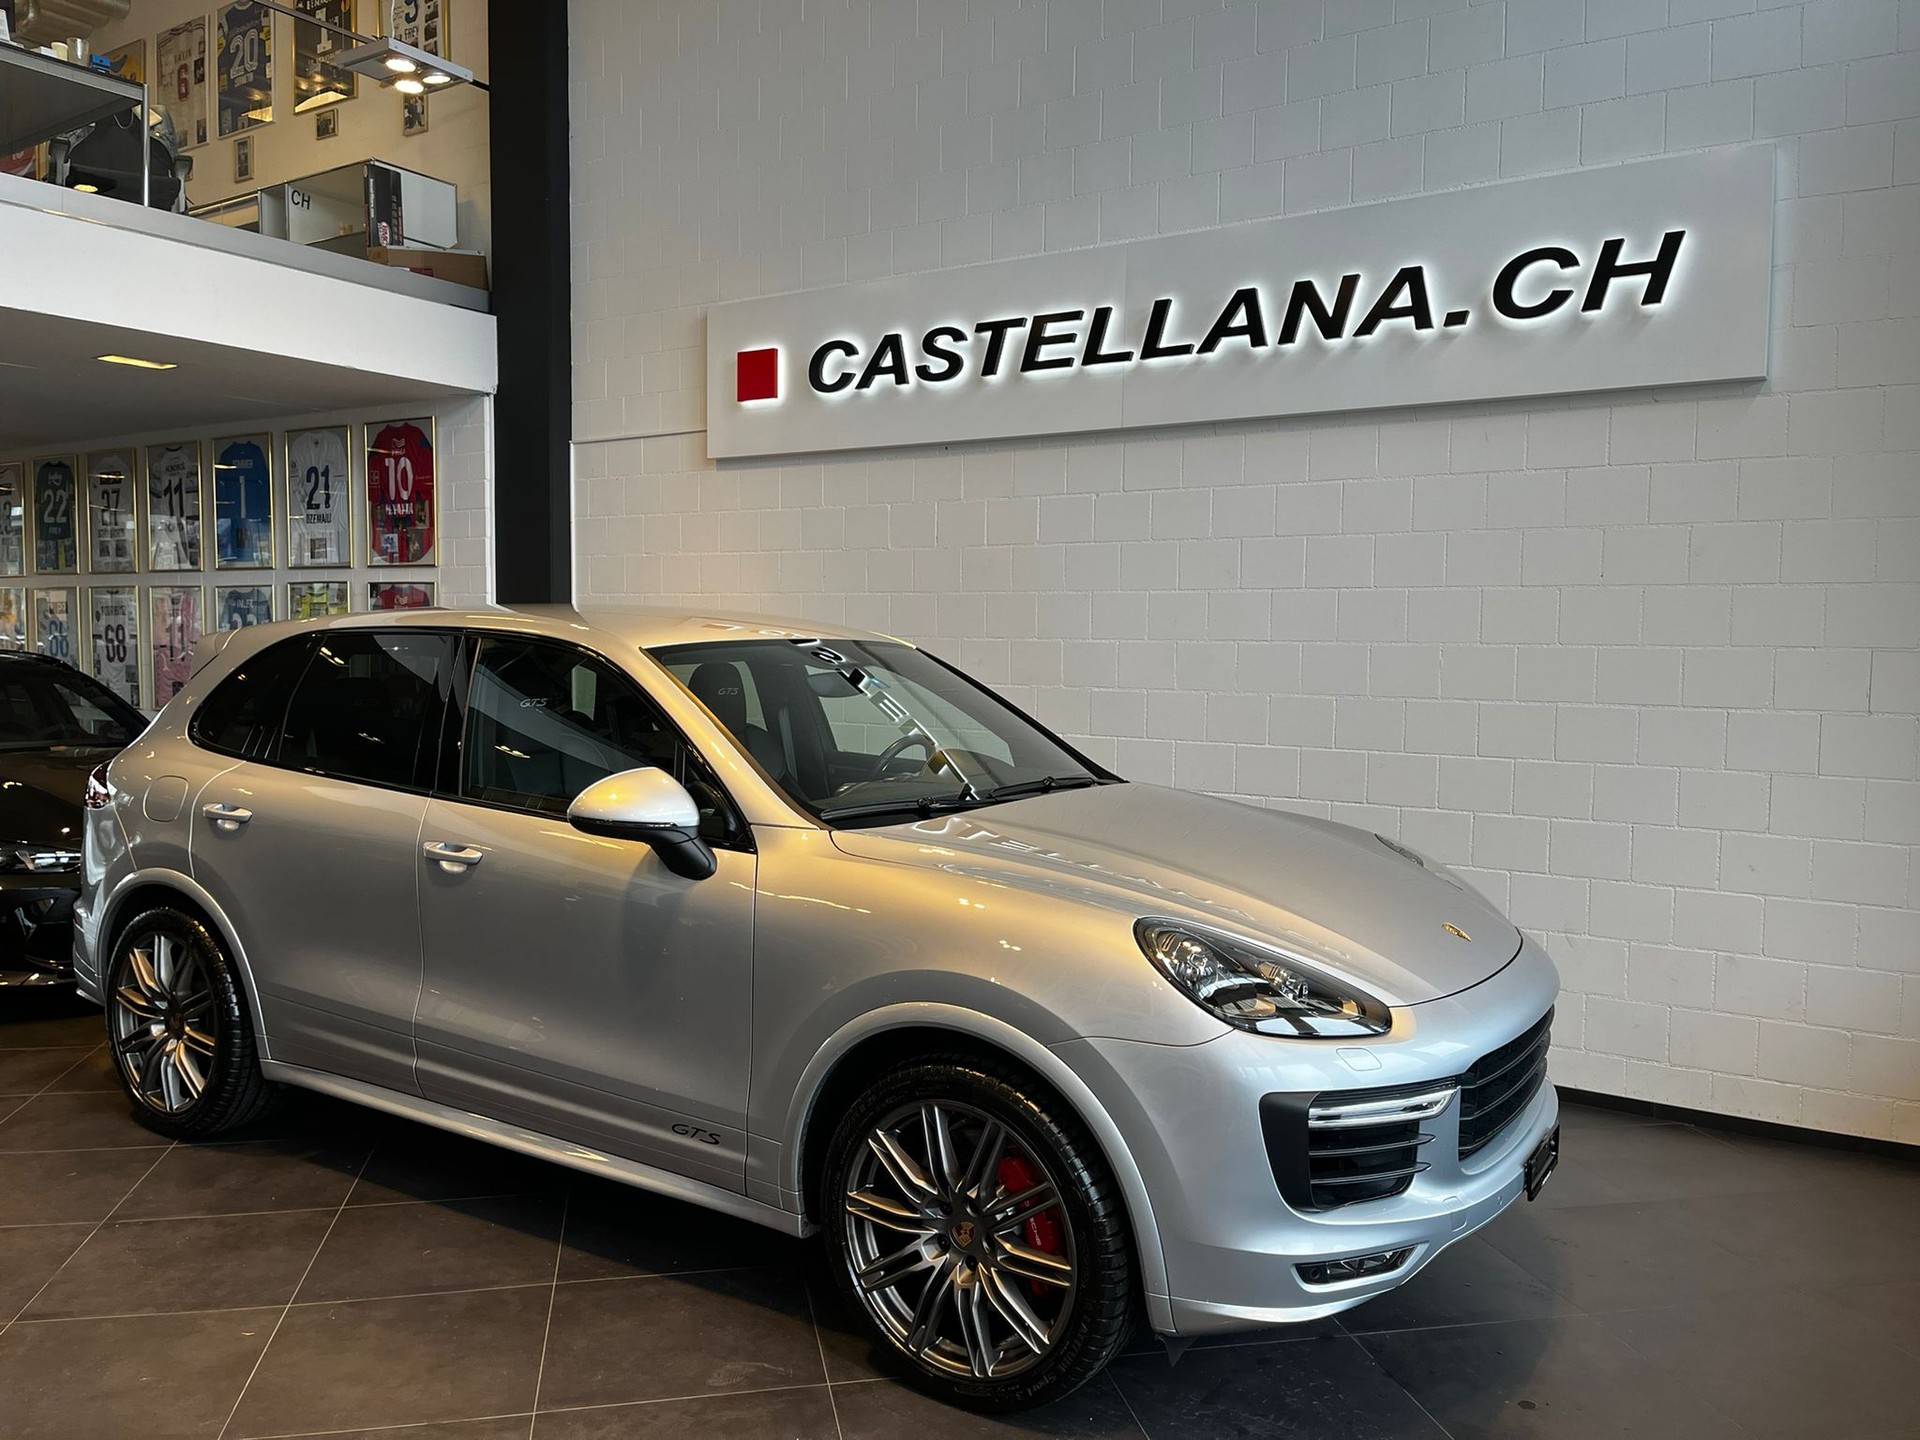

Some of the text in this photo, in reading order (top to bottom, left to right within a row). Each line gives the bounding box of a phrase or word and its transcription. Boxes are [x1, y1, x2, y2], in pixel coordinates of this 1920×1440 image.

[230, 28, 259, 80] 20
[176, 62, 190, 103] 6
[291, 189, 311, 211] CH
[808, 229, 1687, 394] CASTELLANA.CH
[163, 478, 185, 518] 11
[239, 475, 247, 519] 1
[306, 465, 331, 510] 21
[385, 456, 414, 501] 10
[43, 489, 68, 524] 22
[101, 486, 121, 527] 27
[519, 697, 548, 708] GTS
[717, 687, 739, 697] GTS
[671, 1123, 722, 1146] GTS
